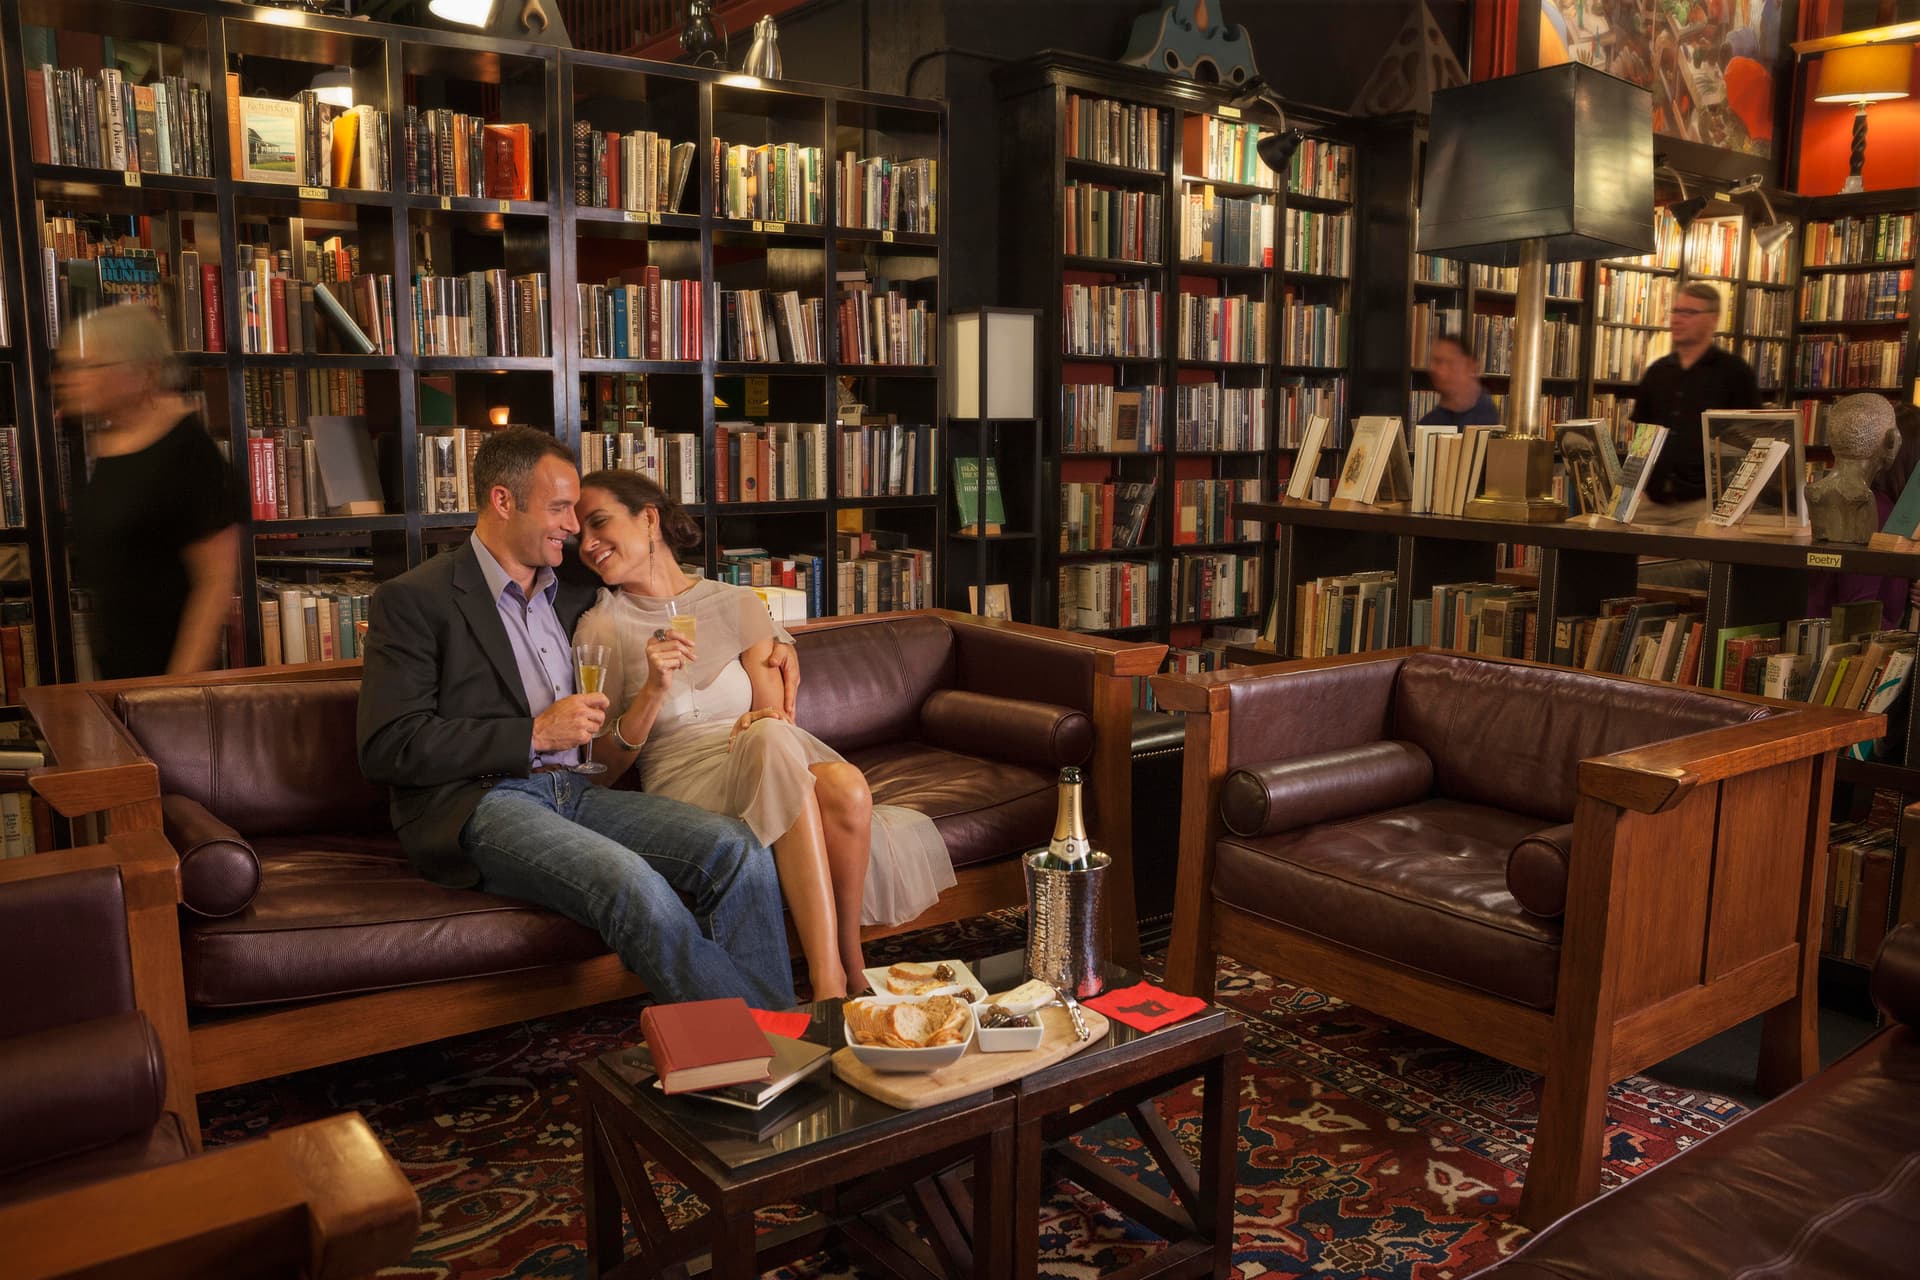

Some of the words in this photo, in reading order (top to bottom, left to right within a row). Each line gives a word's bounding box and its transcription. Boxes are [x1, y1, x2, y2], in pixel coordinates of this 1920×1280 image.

[128, 173, 137, 183] H
[301, 188, 327, 198] Fiction
[765, 223, 785, 232] Fiction
[101, 256, 135, 270] EVAN
[102, 269, 159, 282] HUNTER
[1809, 554, 1840, 567] Poetry
